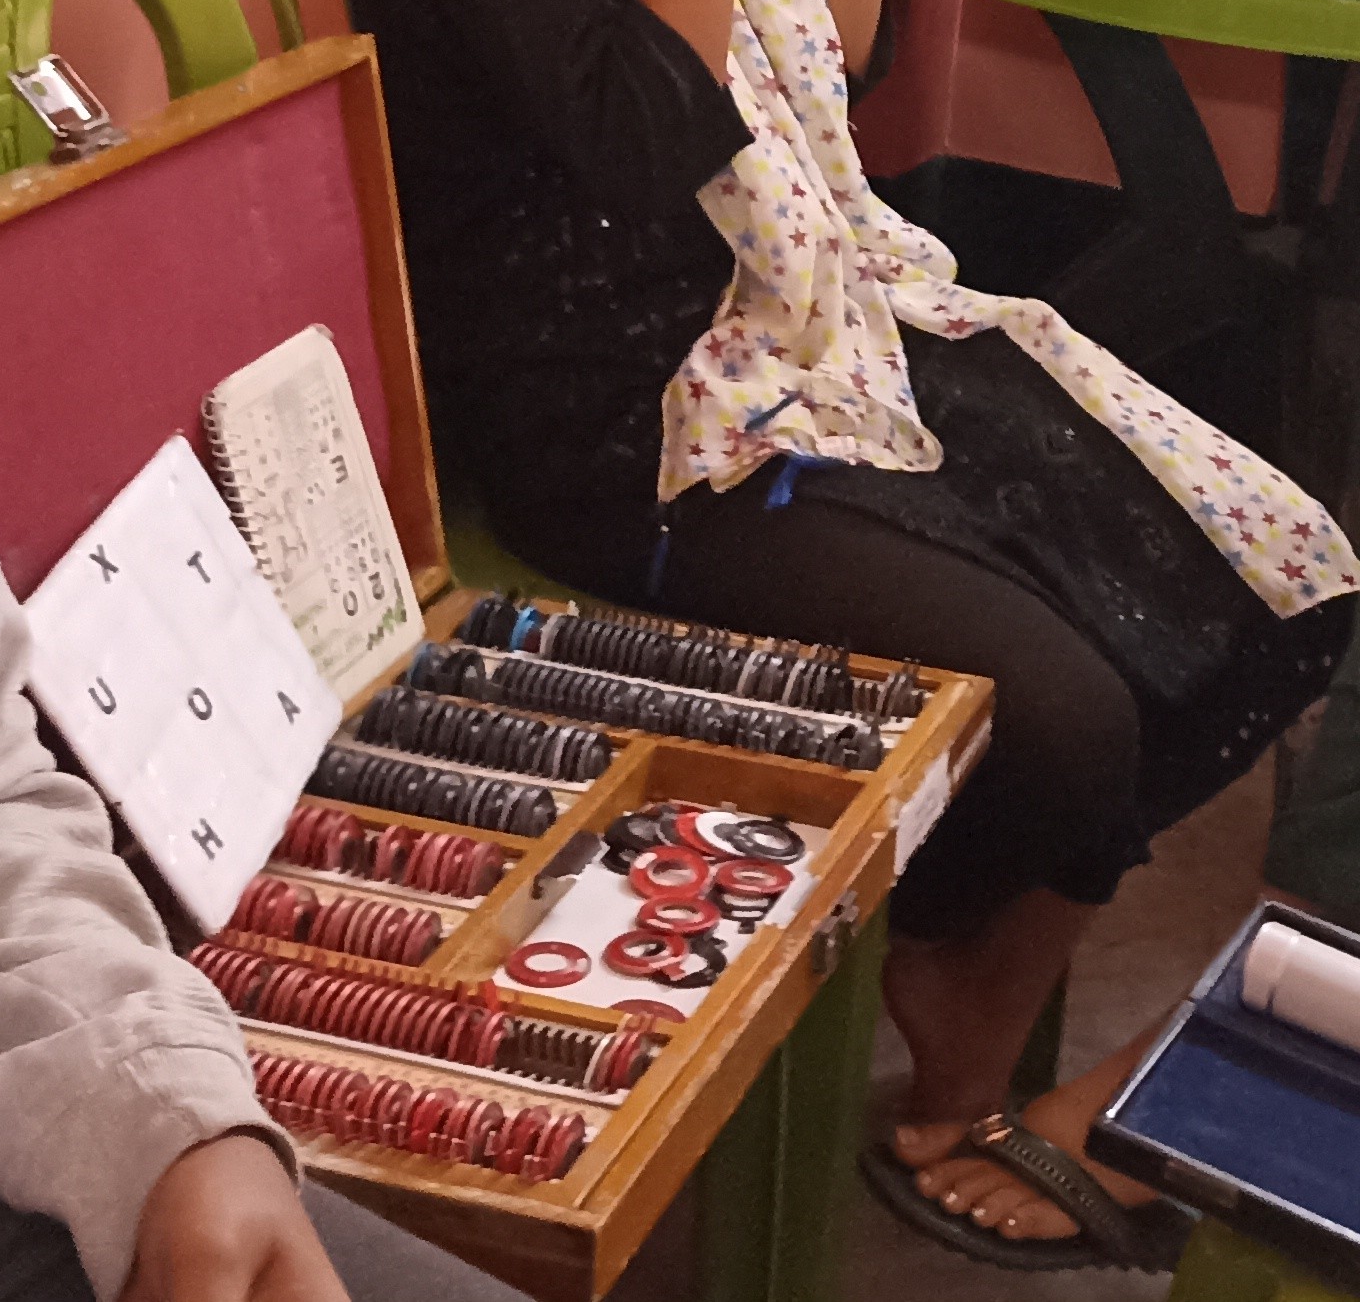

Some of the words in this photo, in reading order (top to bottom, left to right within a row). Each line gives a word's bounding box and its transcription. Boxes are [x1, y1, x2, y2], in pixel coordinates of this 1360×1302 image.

[87, 543, 120, 584] X
[186, 550, 212, 584] T
[87, 677, 118, 716] U
[186, 686, 214, 722] O
[276, 690, 301, 724] A
[191, 818, 224, 860] H
